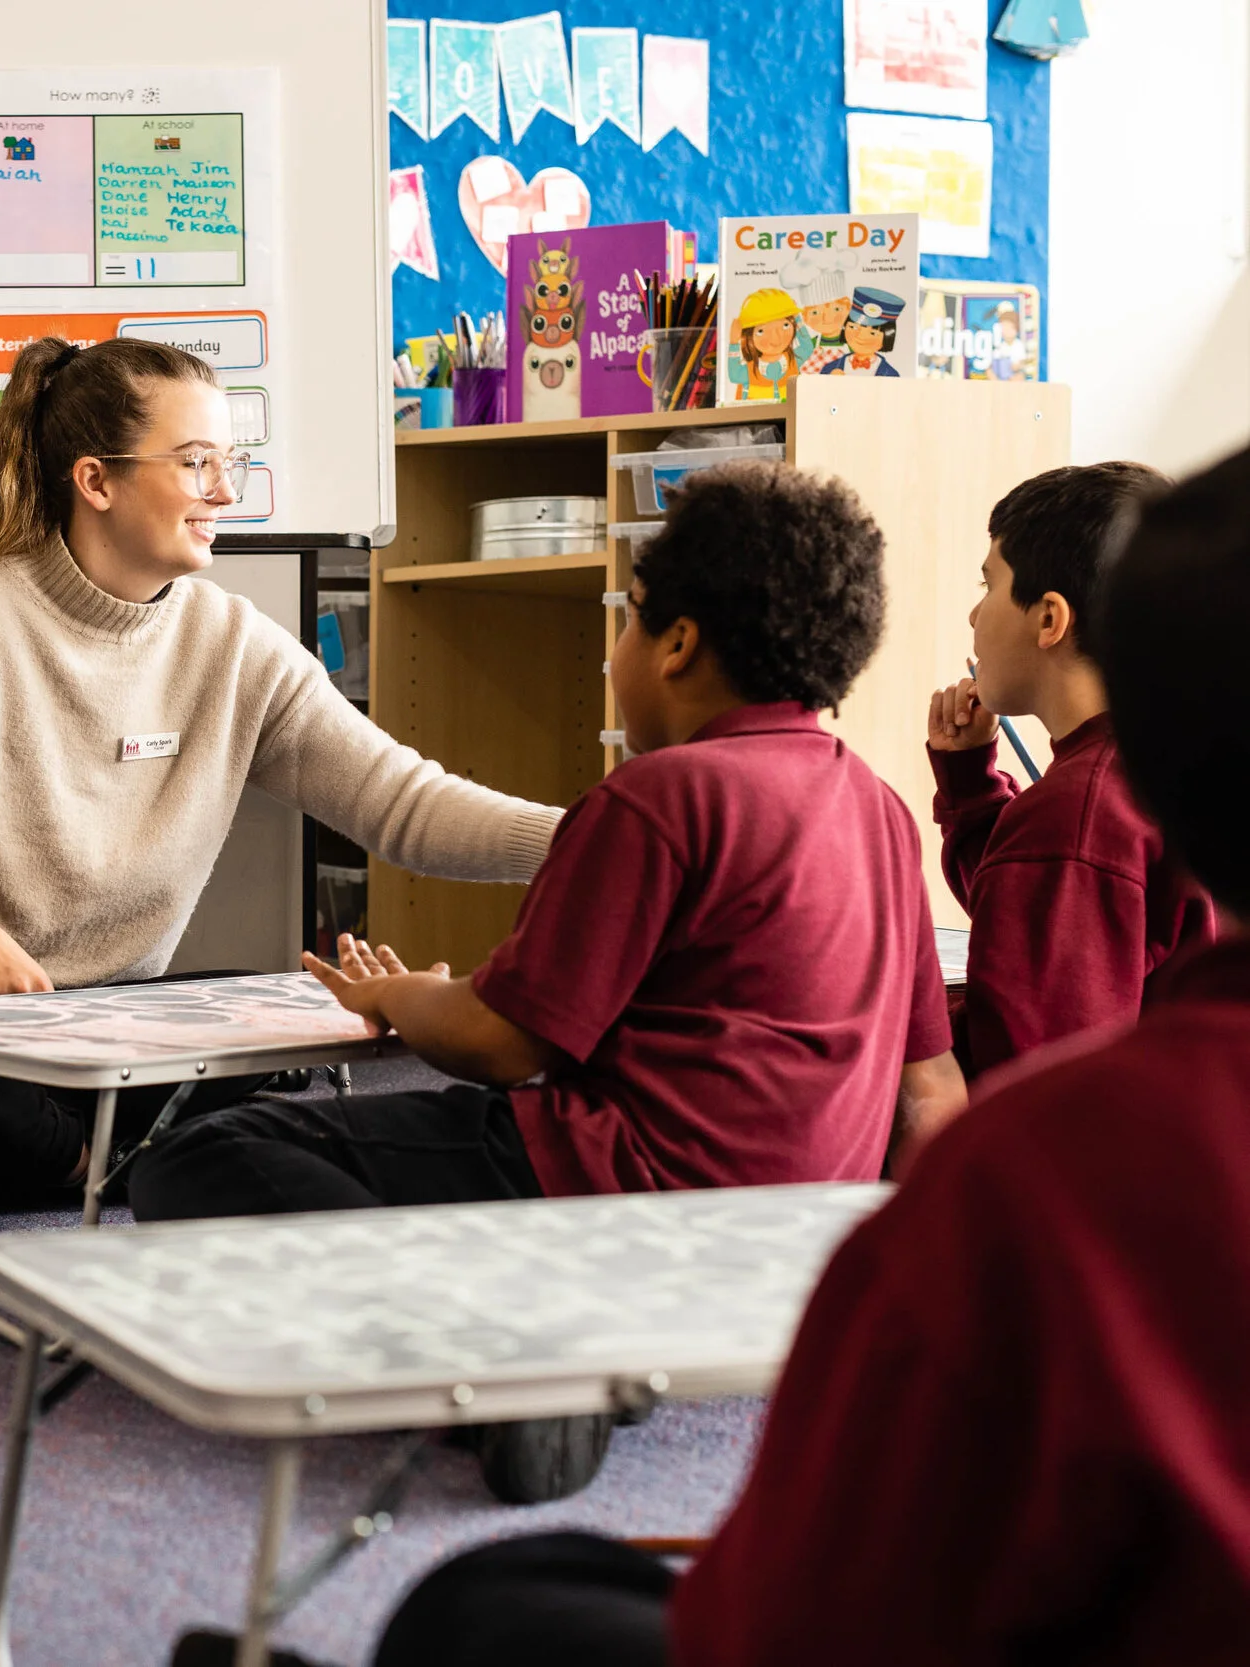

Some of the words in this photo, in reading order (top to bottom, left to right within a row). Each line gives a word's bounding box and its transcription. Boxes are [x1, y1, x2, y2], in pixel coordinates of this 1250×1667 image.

[50, 90, 81, 101] How
[86, 89, 134, 103] many?
[12, 121, 45, 131] home
[142, 120, 154, 130] At
[157, 120, 195, 130] school
[102, 162, 180, 176] Hamzah
[190, 160, 230, 175] Jim
[98, 176, 162, 189] Darren
[102, 190, 148, 203] Dane
[167, 192, 226, 214] Henry
[170, 206, 230, 223] Adam
[102, 218, 129, 228] Kai
[101, 229, 169, 243] Massimo
[735, 225, 838, 250] Career
[847, 221, 906, 253] Day
[616, 273, 631, 291] A
[616, 313, 632, 332] of
[164, 339, 221, 355] onday
